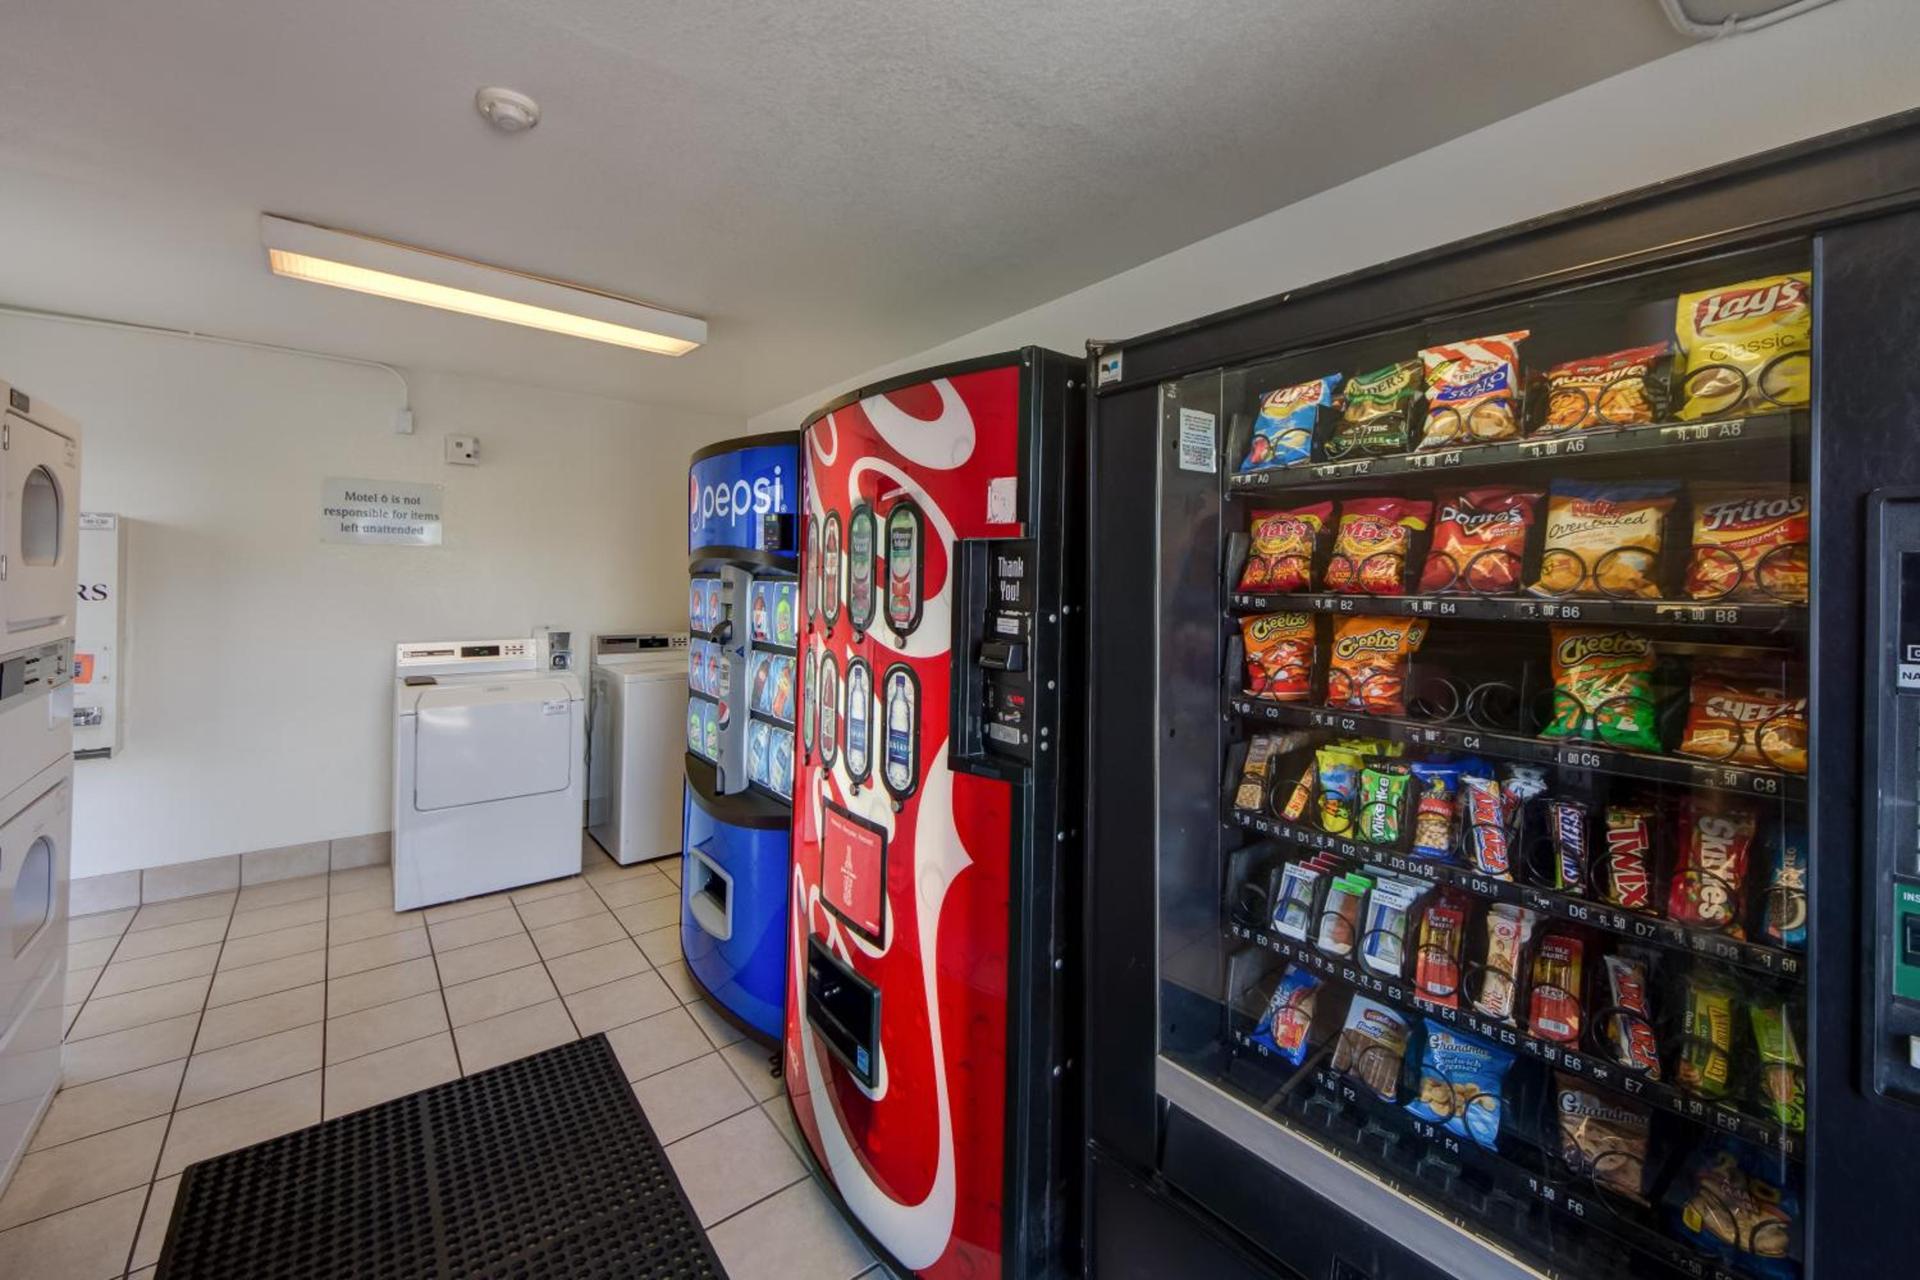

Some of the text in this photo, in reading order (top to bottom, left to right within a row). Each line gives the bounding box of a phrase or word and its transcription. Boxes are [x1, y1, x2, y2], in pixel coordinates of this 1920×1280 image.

[1699, 280, 1804, 326] Lay's
[1719, 422, 1741, 436] A8
[1566, 439, 1584, 452] A6
[1445, 454, 1459, 465] A4
[1356, 463, 1368, 474] A2
[344, 490, 421, 506] Motel 6 is not
[701, 466, 782, 527] pepsi
[324, 507, 440, 521] responsible for items
[1441, 506, 1523, 526] Doritos
[1703, 496, 1804, 531] Fritos
[341, 522, 424, 535] left unattended
[997, 556, 1024, 578] Thank
[1000, 580, 1020, 601] You!
[1341, 600, 1353, 610] B2
[1441, 602, 1456, 614] B4
[1562, 606, 1580, 618] B6
[1715, 609, 1737, 623] B8
[1253, 611, 1307, 639] Cheetos
[1338, 630, 1400, 658] Cheetos
[1560, 634, 1648, 664] Cheetos
[1342, 718, 1356, 730] C2
[1463, 736, 1480, 749] C4
[1581, 753, 1600, 768] C6
[1753, 777, 1778, 794] C8
[1297, 831, 1309, 844] D1
[1342, 843, 1356, 857] D2
[1391, 857, 1406, 870] D3
[1408, 863, 1423, 875] D4
[1607, 819, 1648, 907] TWIX
[1472, 878, 1488, 893] D5
[1568, 903, 1588, 920] D6
[1635, 921, 1656, 938] D7
[1298, 950, 1309, 963] E1
[1716, 942, 1739, 961] D8
[1343, 967, 1356, 981] E2
[1388, 985, 1401, 1000] E3
[1441, 1006, 1456, 1022] E4
[1501, 1029, 1517, 1046] E5
[1563, 1053, 1583, 1072] E6
[1624, 1076, 1644, 1094] E7
[1343, 1086, 1356, 1102] F2
[1715, 1111, 1738, 1132] E8
[1445, 1136, 1459, 1154] F4
